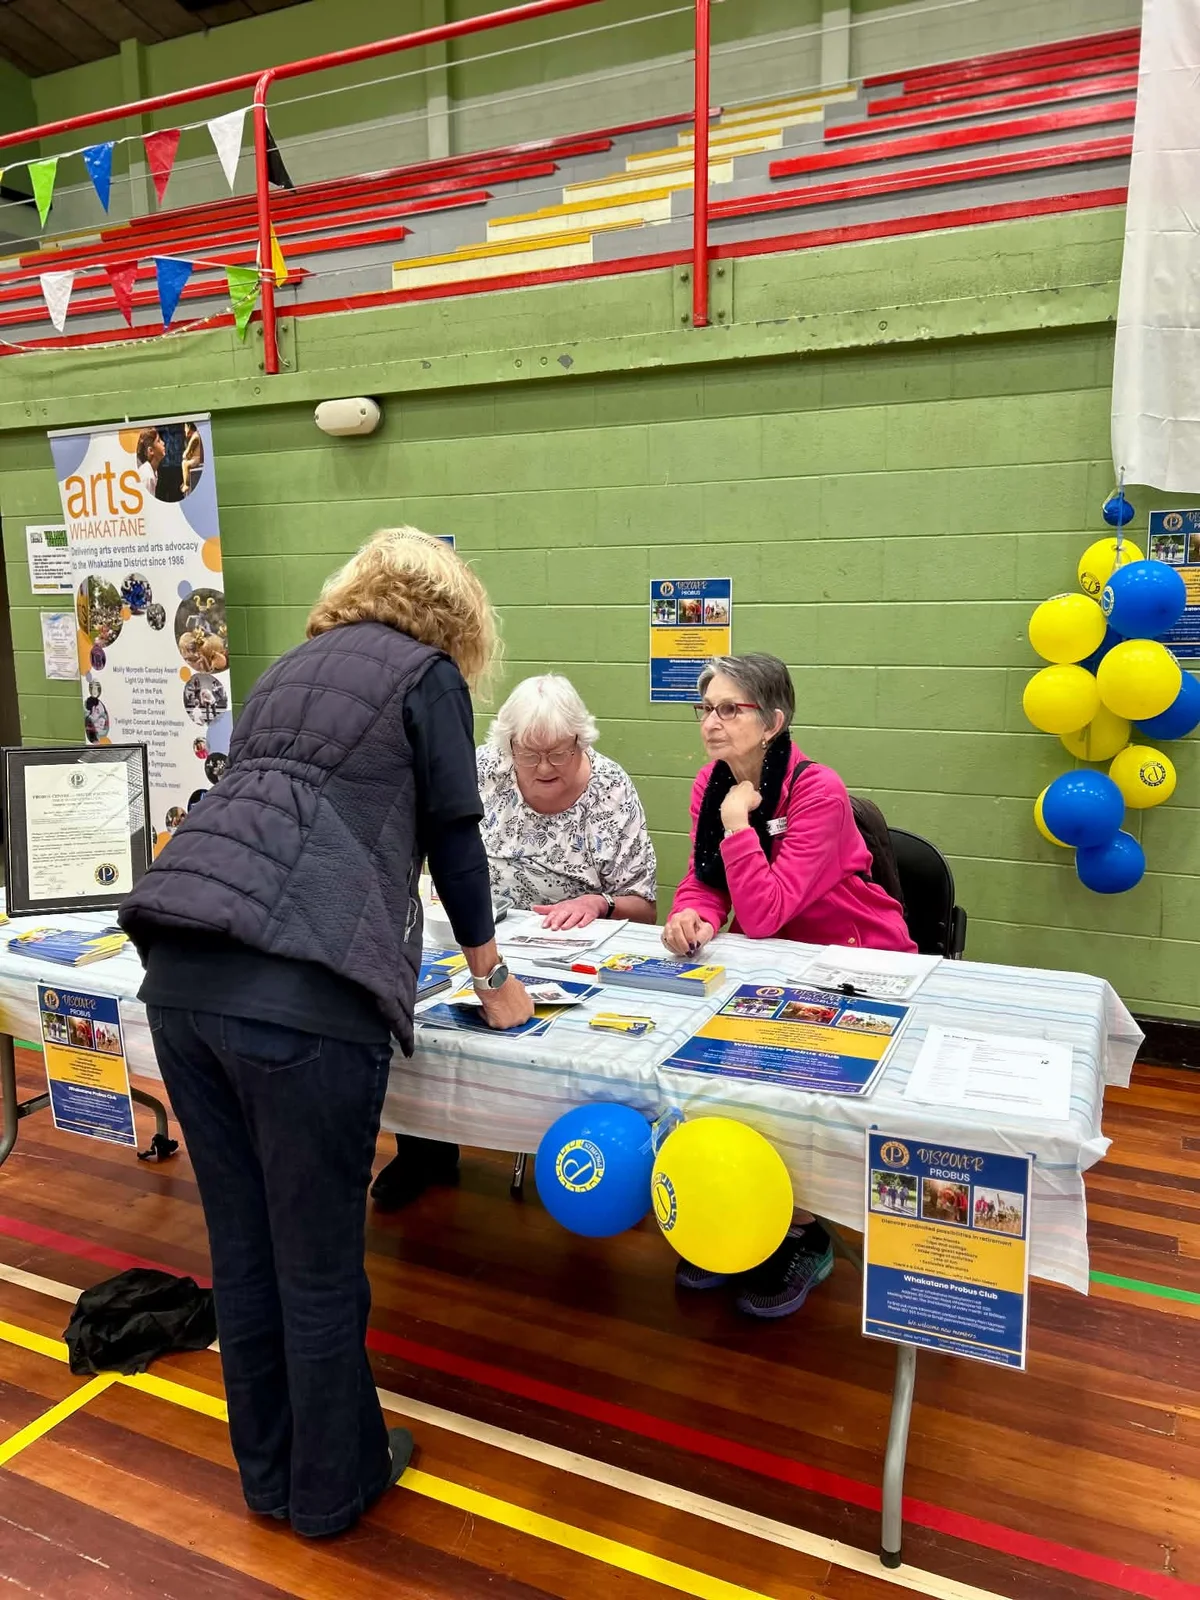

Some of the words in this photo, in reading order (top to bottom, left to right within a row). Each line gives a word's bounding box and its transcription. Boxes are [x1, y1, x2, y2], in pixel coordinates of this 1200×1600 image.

[65, 462, 144, 519] arts
[69, 518, 146, 540] WHAKATĀNE
[71, 546, 98, 557] Delivering
[100, 546, 111, 554] arts
[113, 544, 136, 554] events
[138, 543, 149, 552] and
[151, 543, 163, 552] arts
[165, 541, 199, 552] advocacy
[72, 562, 77, 570] to
[78, 560, 87, 569] the
[88, 558, 122, 568] Whakatāne
[124, 556, 147, 567] District
[149, 556, 166, 566] since
[798, 996, 839, 1006] PROBUS
[69, 1008, 91, 1018] PROBUS
[917, 1149, 984, 1171] DISCOVER
[930, 1168, 970, 1181] PROBUS
[881, 1218, 907, 1227] Discover
[908, 1223, 935, 1232] unlimited
[936, 1228, 972, 1240] possibilities
[979, 1236, 1012, 1246] retirement
[904, 1275, 949, 1290] Whakatane
[950, 1284, 977, 1296] Probus
[979, 1289, 998, 1300] Club
[917, 1320, 939, 1331] welcome
